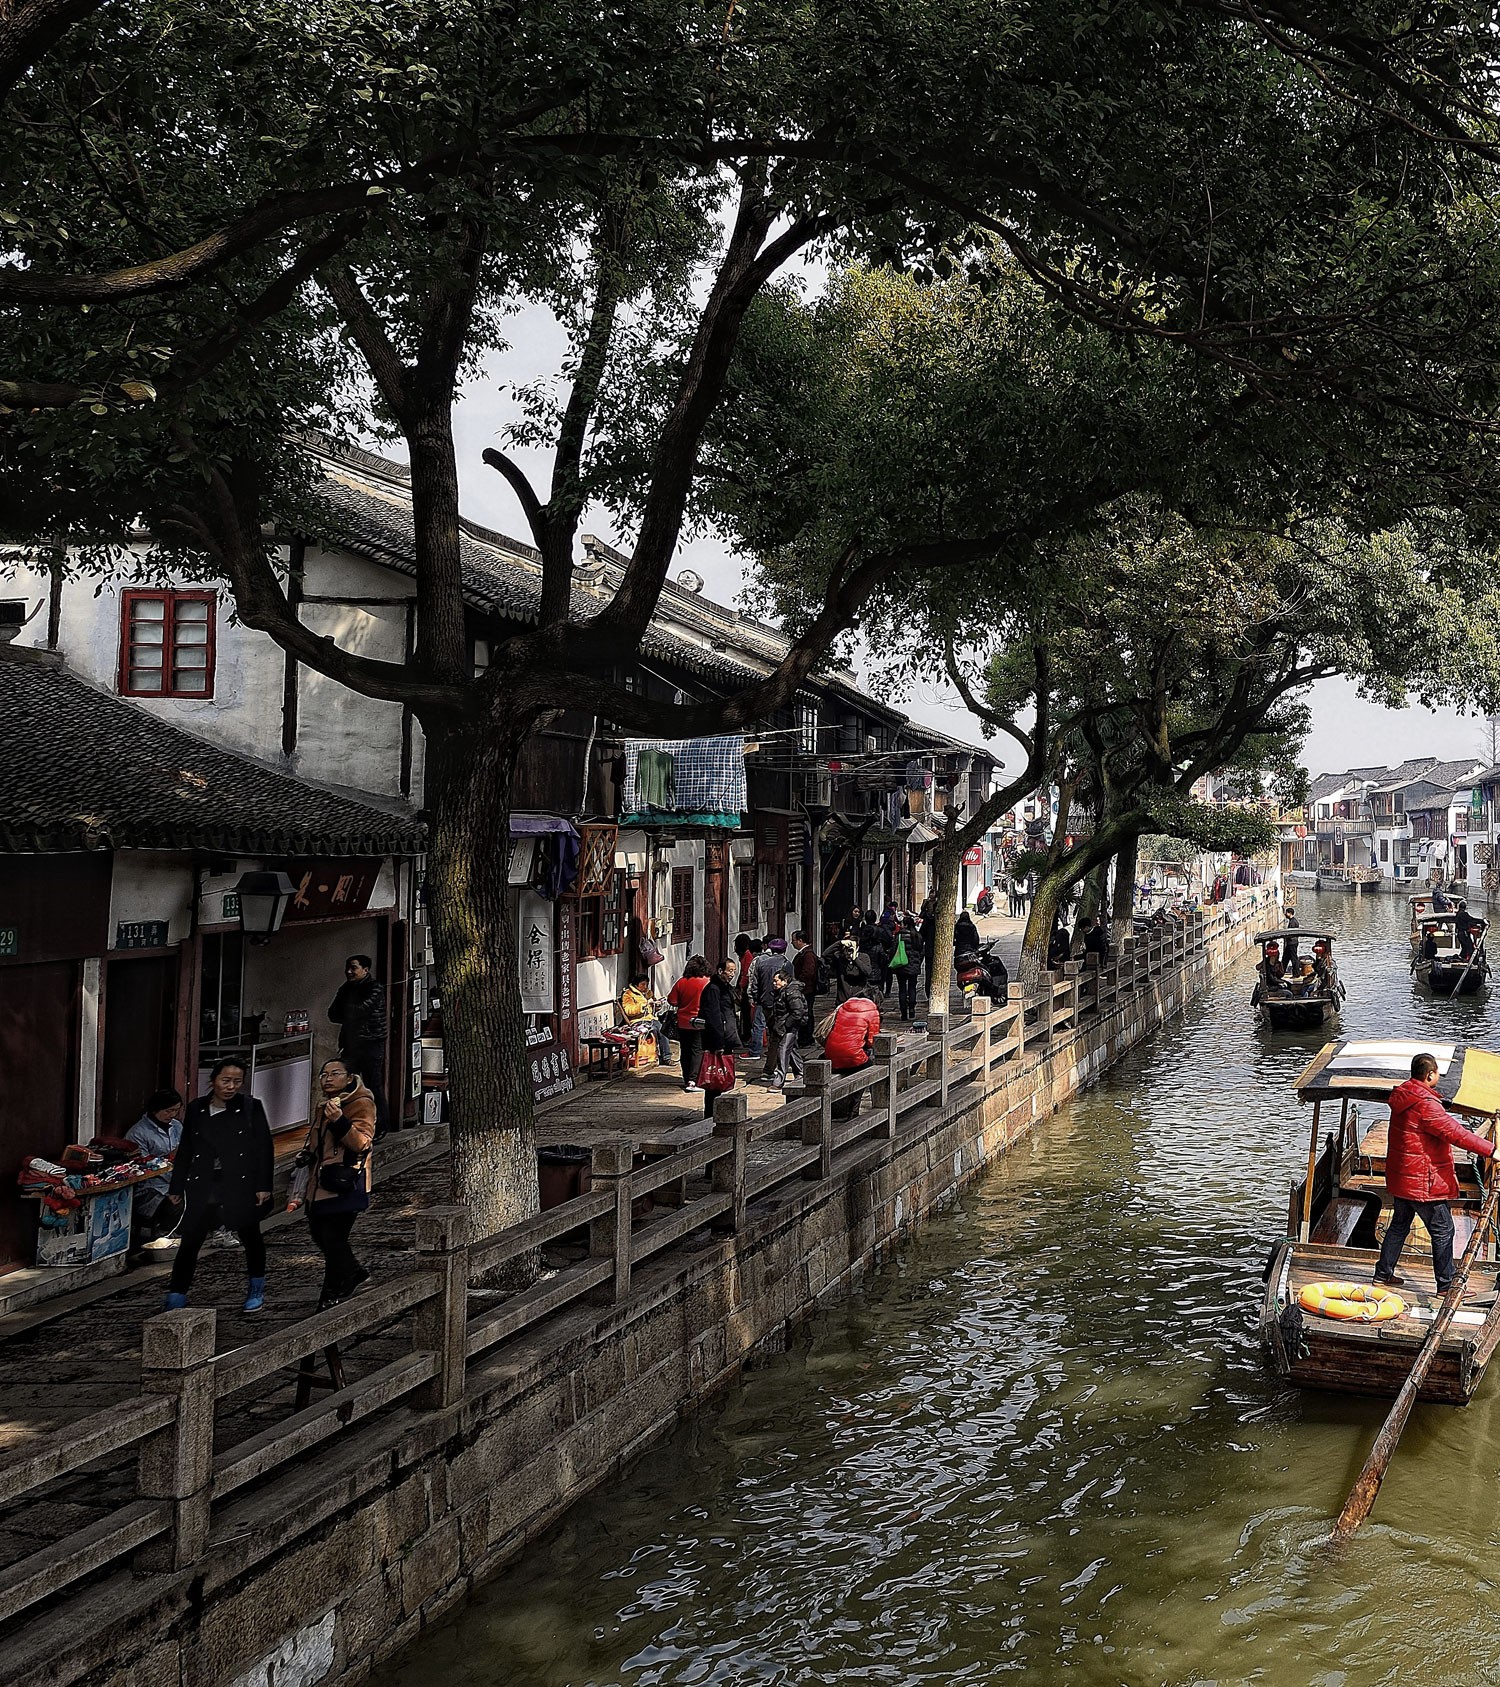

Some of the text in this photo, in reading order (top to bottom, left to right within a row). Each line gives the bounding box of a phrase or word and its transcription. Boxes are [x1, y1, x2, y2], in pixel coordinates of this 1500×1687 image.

[965, 850, 979, 862] illy
[127, 925, 145, 938] 131
[525, 923, 548, 969] 舍得
